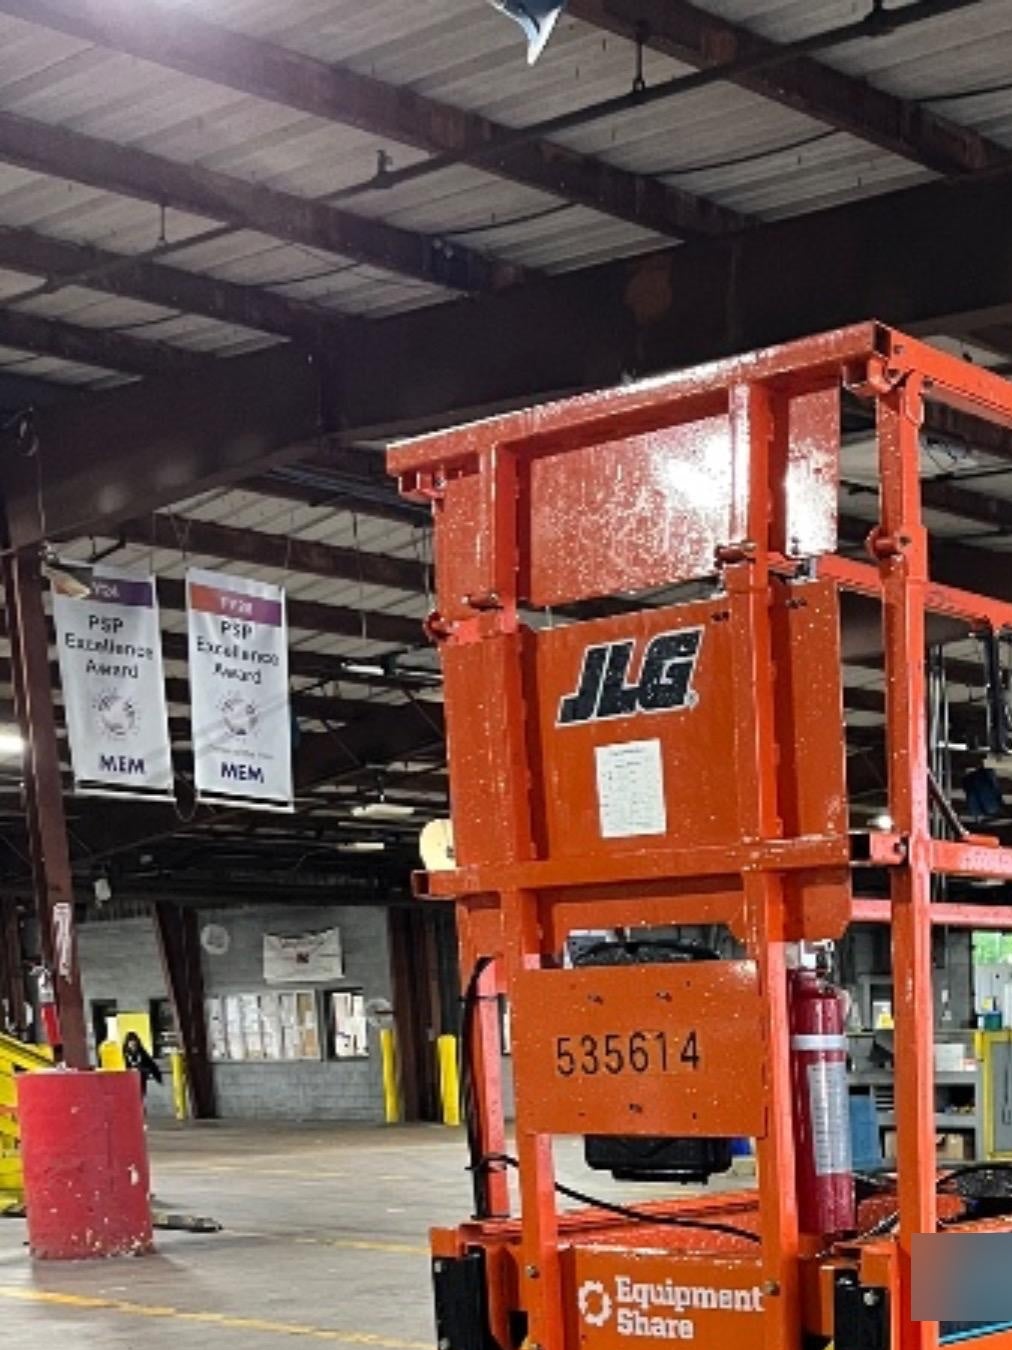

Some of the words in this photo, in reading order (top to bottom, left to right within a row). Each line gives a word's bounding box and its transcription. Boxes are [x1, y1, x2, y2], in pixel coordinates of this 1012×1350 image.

[88, 615, 123, 633] PSP
[220, 620, 252, 640] PSP
[64, 632, 154, 660] Excellence
[196, 635, 280, 666] Excellence
[86, 659, 139, 679] Award
[213, 662, 262, 685] Award
[555, 624, 706, 729] JLG
[98, 754, 146, 775] MEM
[220, 761, 265, 784] MEM
[556, 1029, 701, 1077] 535614
[614, 1275, 766, 1312] Equipment
[616, 1308, 695, 1339] Share
